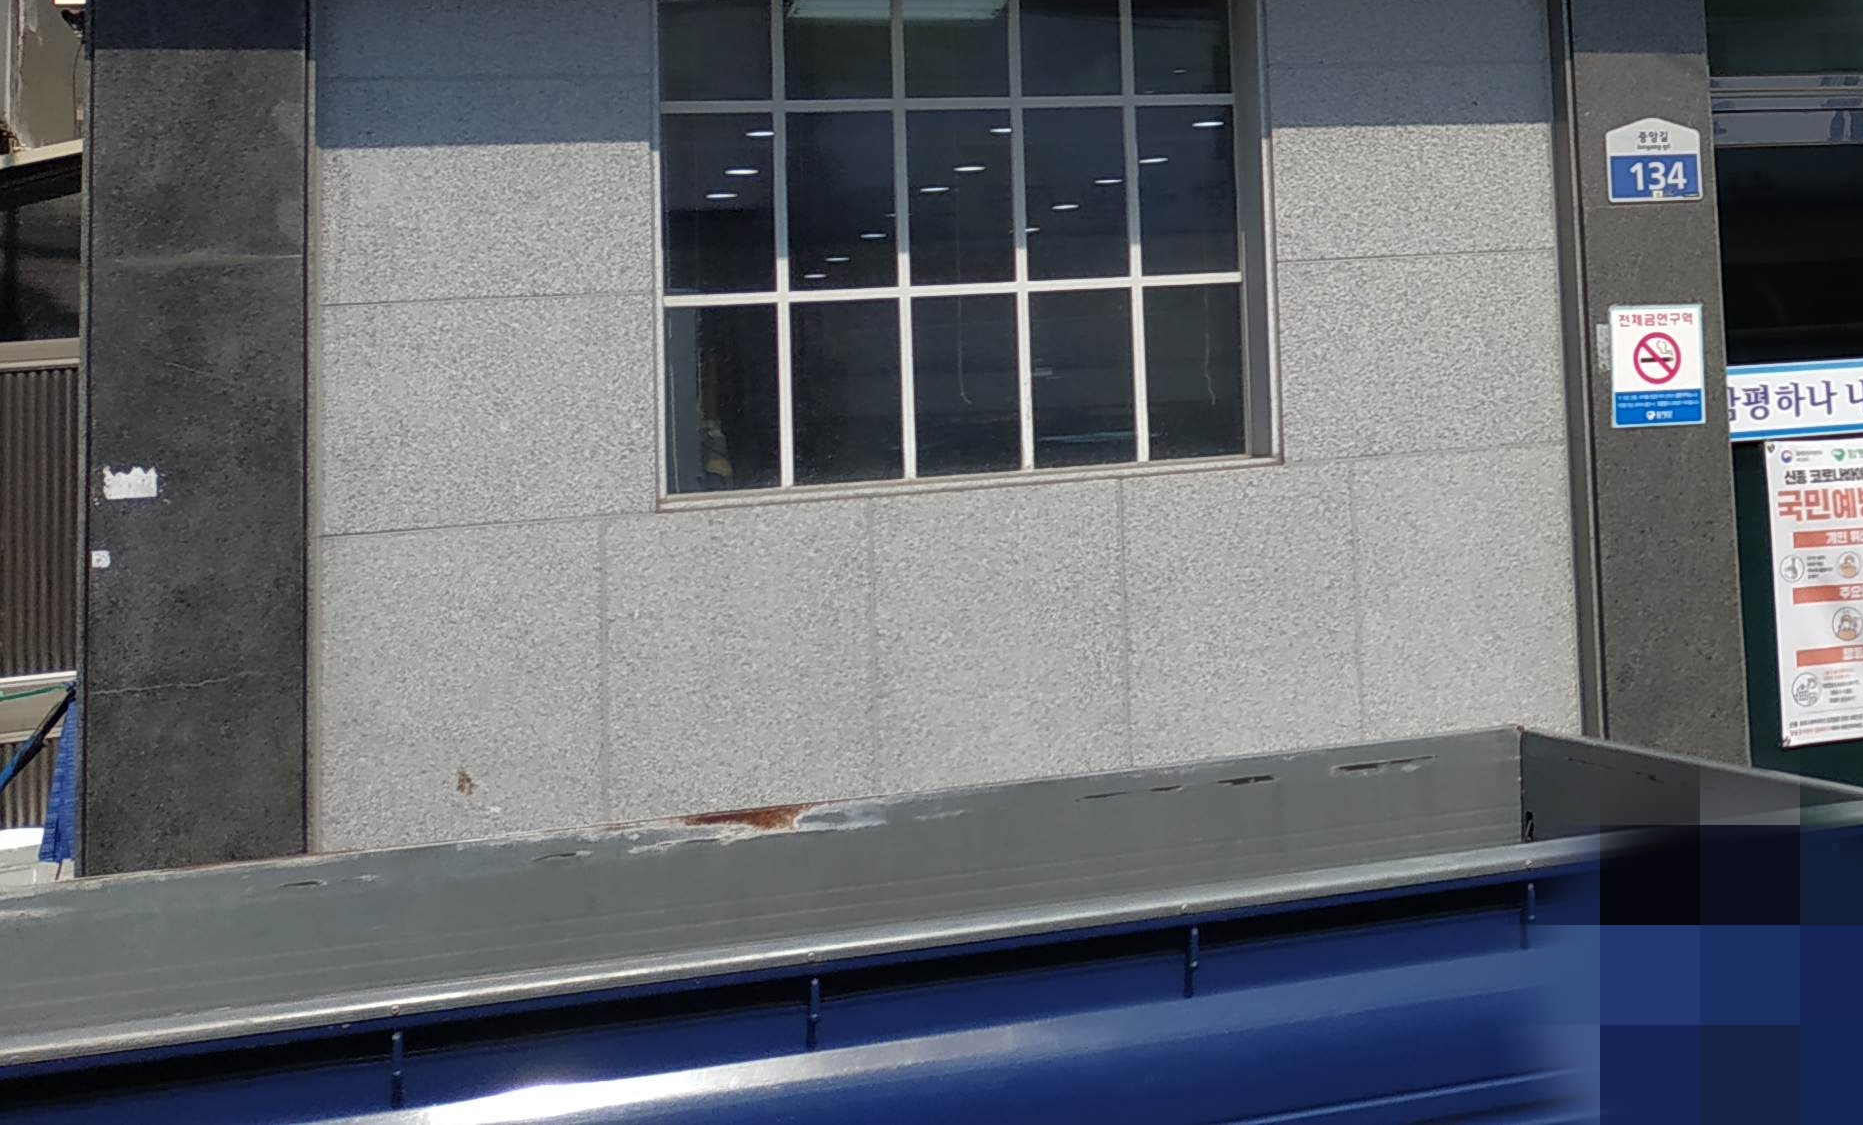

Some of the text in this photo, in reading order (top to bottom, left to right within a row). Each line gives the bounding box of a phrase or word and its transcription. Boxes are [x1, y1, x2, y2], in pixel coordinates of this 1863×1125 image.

[1638, 131, 1669, 143] 중앙길
[1630, 161, 1687, 191] 134
[1619, 312, 1693, 327] 전체금연구역
[1784, 469, 1806, 485] 신종
